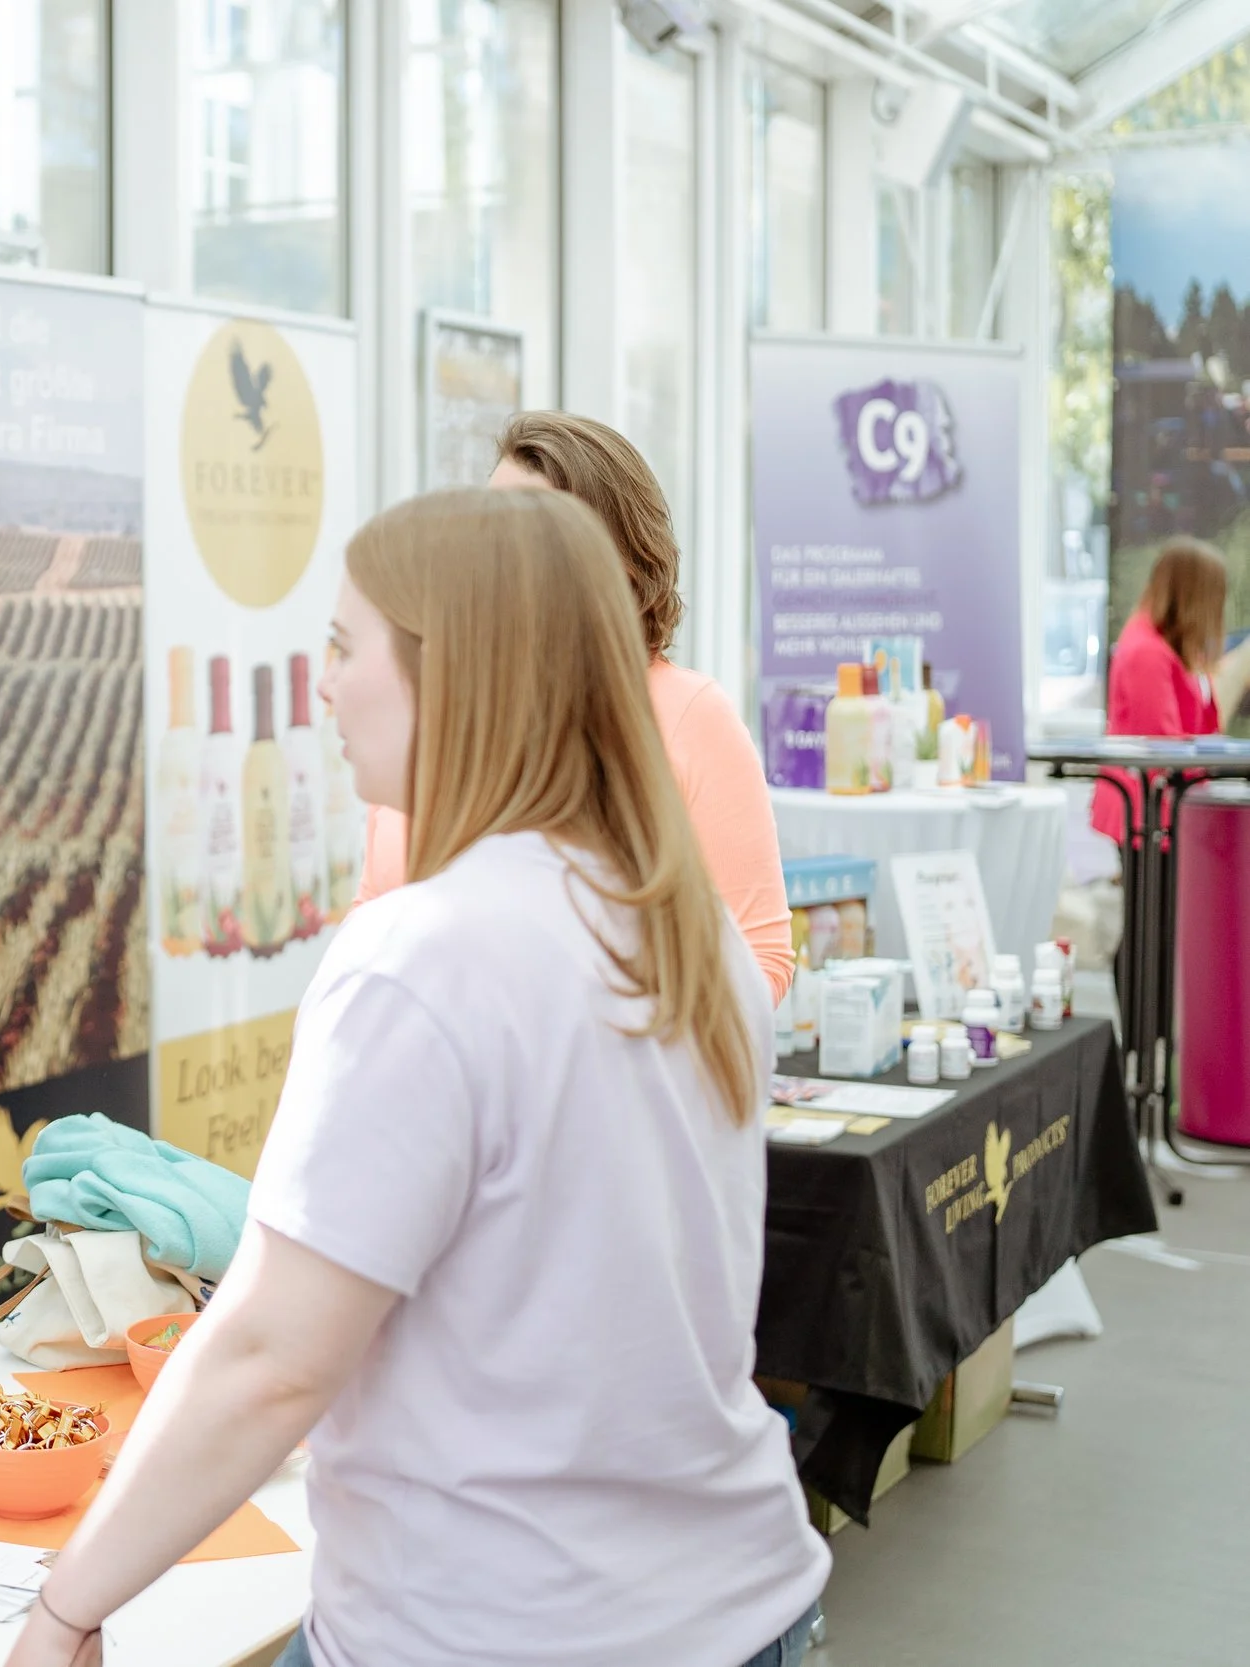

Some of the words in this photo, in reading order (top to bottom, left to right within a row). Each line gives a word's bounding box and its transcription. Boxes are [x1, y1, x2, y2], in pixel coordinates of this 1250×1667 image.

[29, 413, 106, 455] Firma
[857, 398, 928, 482] C9
[194, 460, 311, 498] FOREVER
[176, 1043, 248, 1104] Look
[206, 1097, 267, 1159] Feel
[925, 1153, 978, 1215] FOREVER
